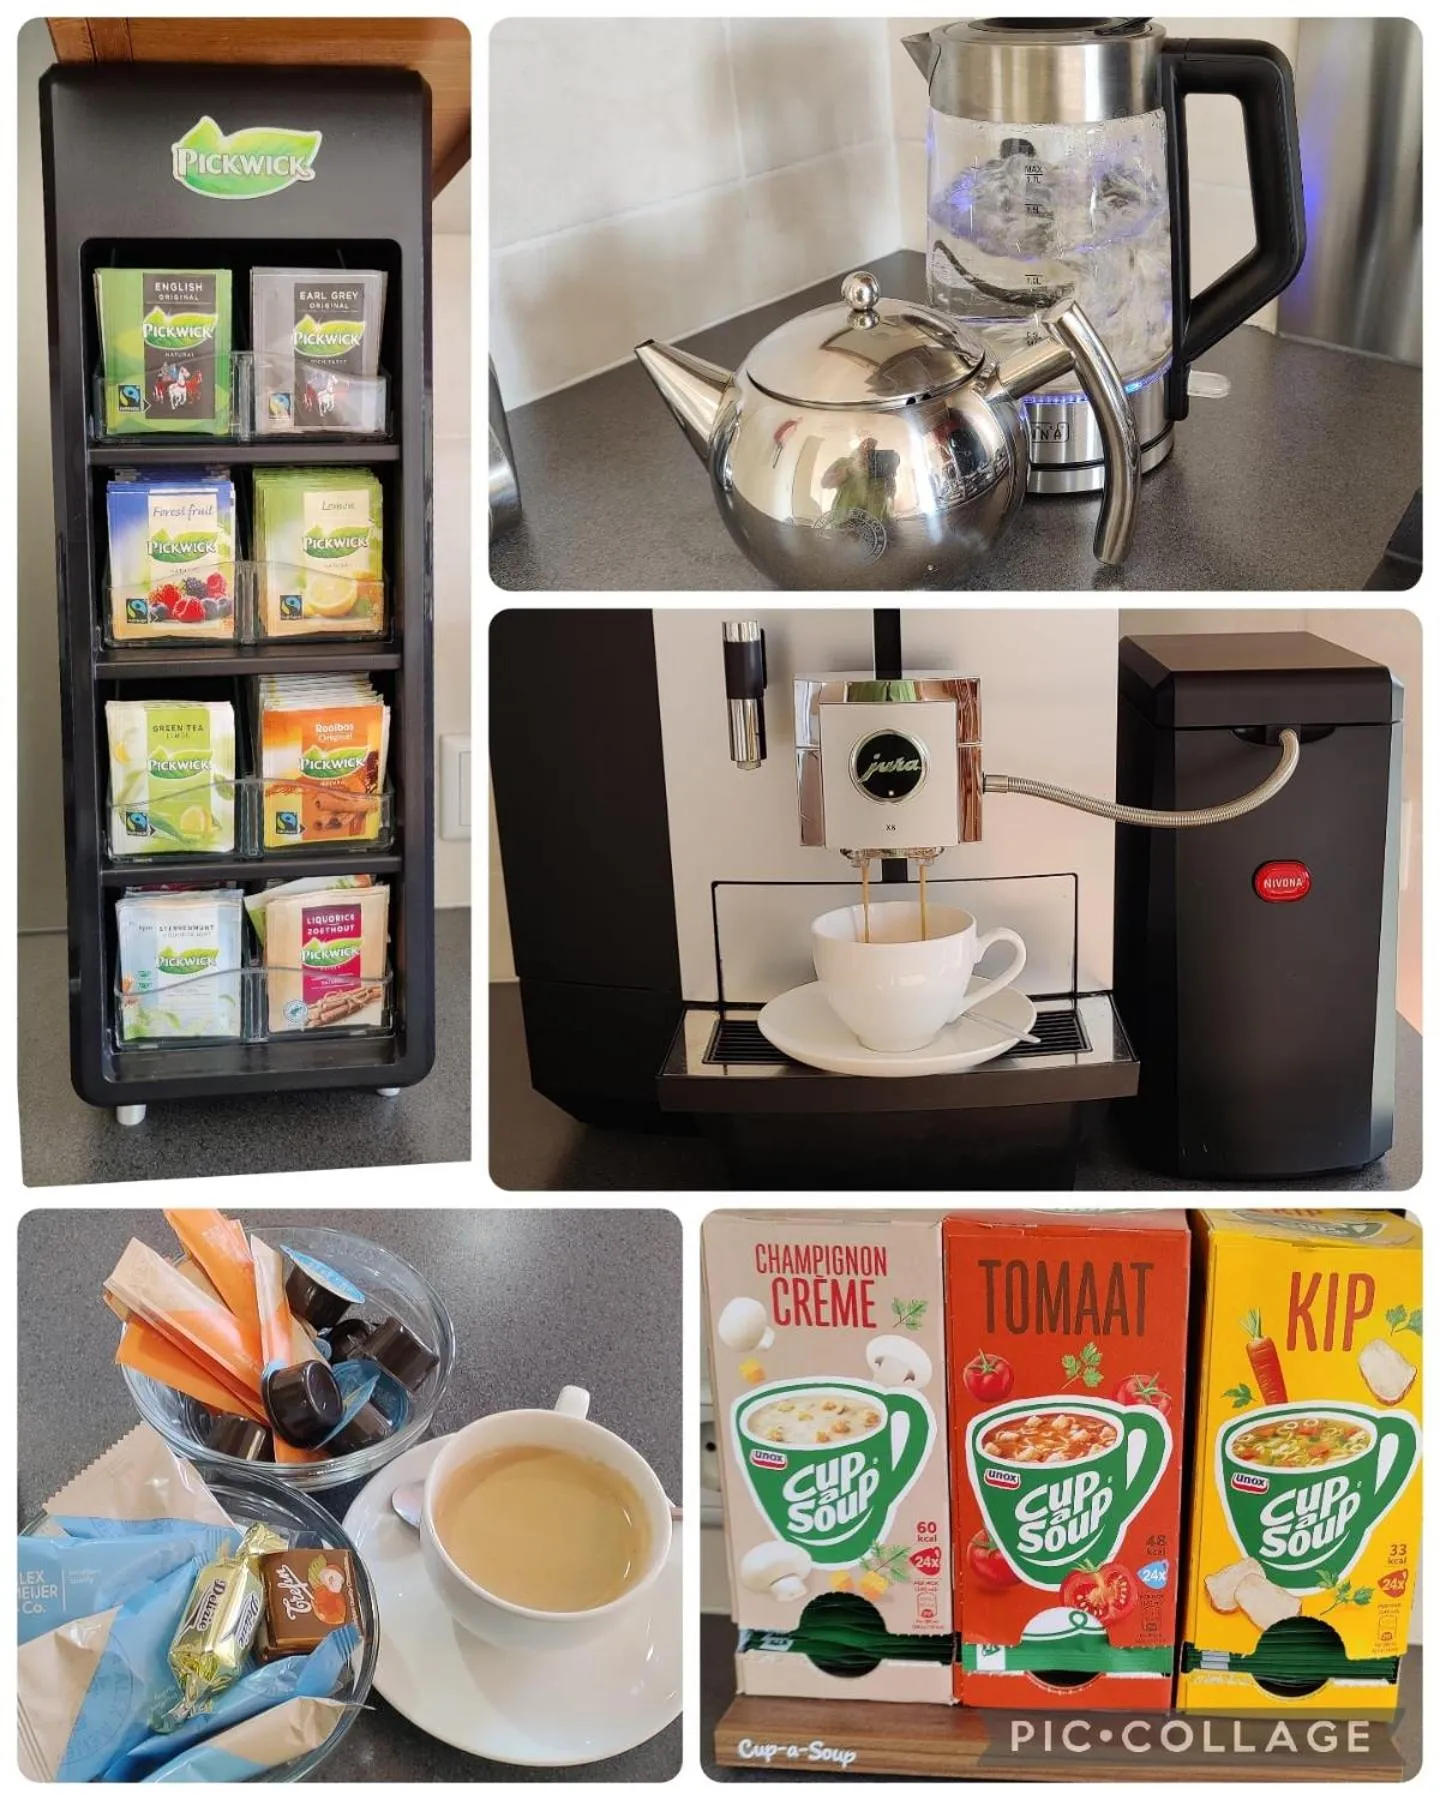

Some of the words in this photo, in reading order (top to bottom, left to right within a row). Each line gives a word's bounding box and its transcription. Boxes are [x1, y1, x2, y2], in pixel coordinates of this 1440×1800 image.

[1025, 165, 1043, 173] MAX
[154, 282, 203, 292] ENGLISH
[299, 291, 327, 300] EARL
[331, 291, 359, 300] GREY
[142, 323, 213, 339] PICKWICK
[292, 331, 361, 346] PICKWICK
[153, 505, 185, 517] Forest
[187, 504, 213, 521] fruit
[321, 501, 355, 511] Lemon
[149, 541, 216, 555] PICKWICK
[304, 536, 368, 550] PICKWICK
[152, 724, 183, 732] GREEN
[186, 724, 204, 732] TEA
[315, 723, 354, 733] Rooibos
[149, 760, 212, 771] PICKWICK
[300, 756, 365, 771] PICKWICK
[857, 753, 922, 784] jura
[1263, 877, 1303, 889] NIVONA
[306, 913, 355, 925] LIQUORICE
[307, 924, 355, 935] ZOETHOUT
[302, 947, 361, 961] PICKWICK
[755, 1243, 888, 1277] CHAMPIGNON
[771, 1275, 877, 1329] CRÈME
[977, 1258, 1154, 1337] TOMAAT
[1286, 1271, 1376, 1352] KIP
[916, 1521, 937, 1534] 60
[917, 1534, 938, 1543] kcal
[1390, 1543, 1407, 1556] 33
[914, 1554, 940, 1568] 24x
[1387, 1557, 1408, 1565] kcal
[1142, 1568, 1166, 1582] 24x
[738, 1739, 857, 1769] Cup-a-Soup
